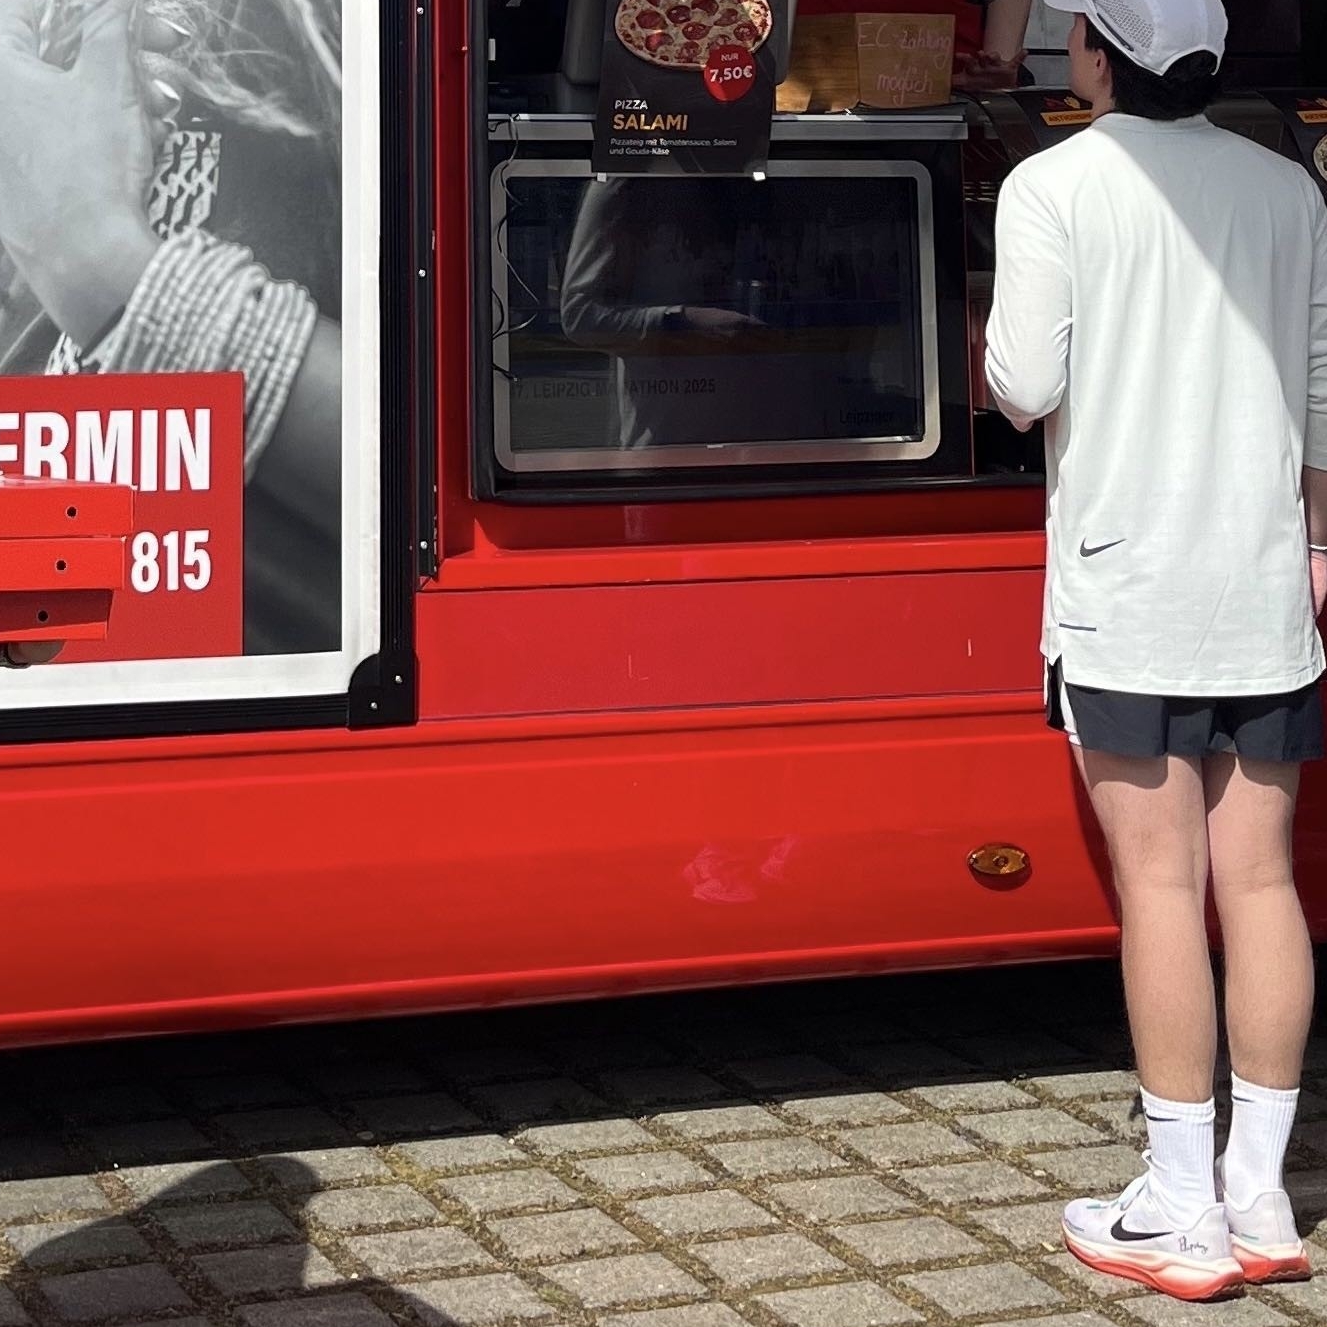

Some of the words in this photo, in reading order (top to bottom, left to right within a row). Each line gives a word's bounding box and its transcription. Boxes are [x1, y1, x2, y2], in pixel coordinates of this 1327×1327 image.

[721, 52, 740, 62] NUR
[709, 65, 753, 83] 7,50€
[614, 99, 649, 110] PIZZA
[612, 113, 689, 131] SALAMI
[609, 147, 624, 155] und
[131, 530, 211, 592] 815
